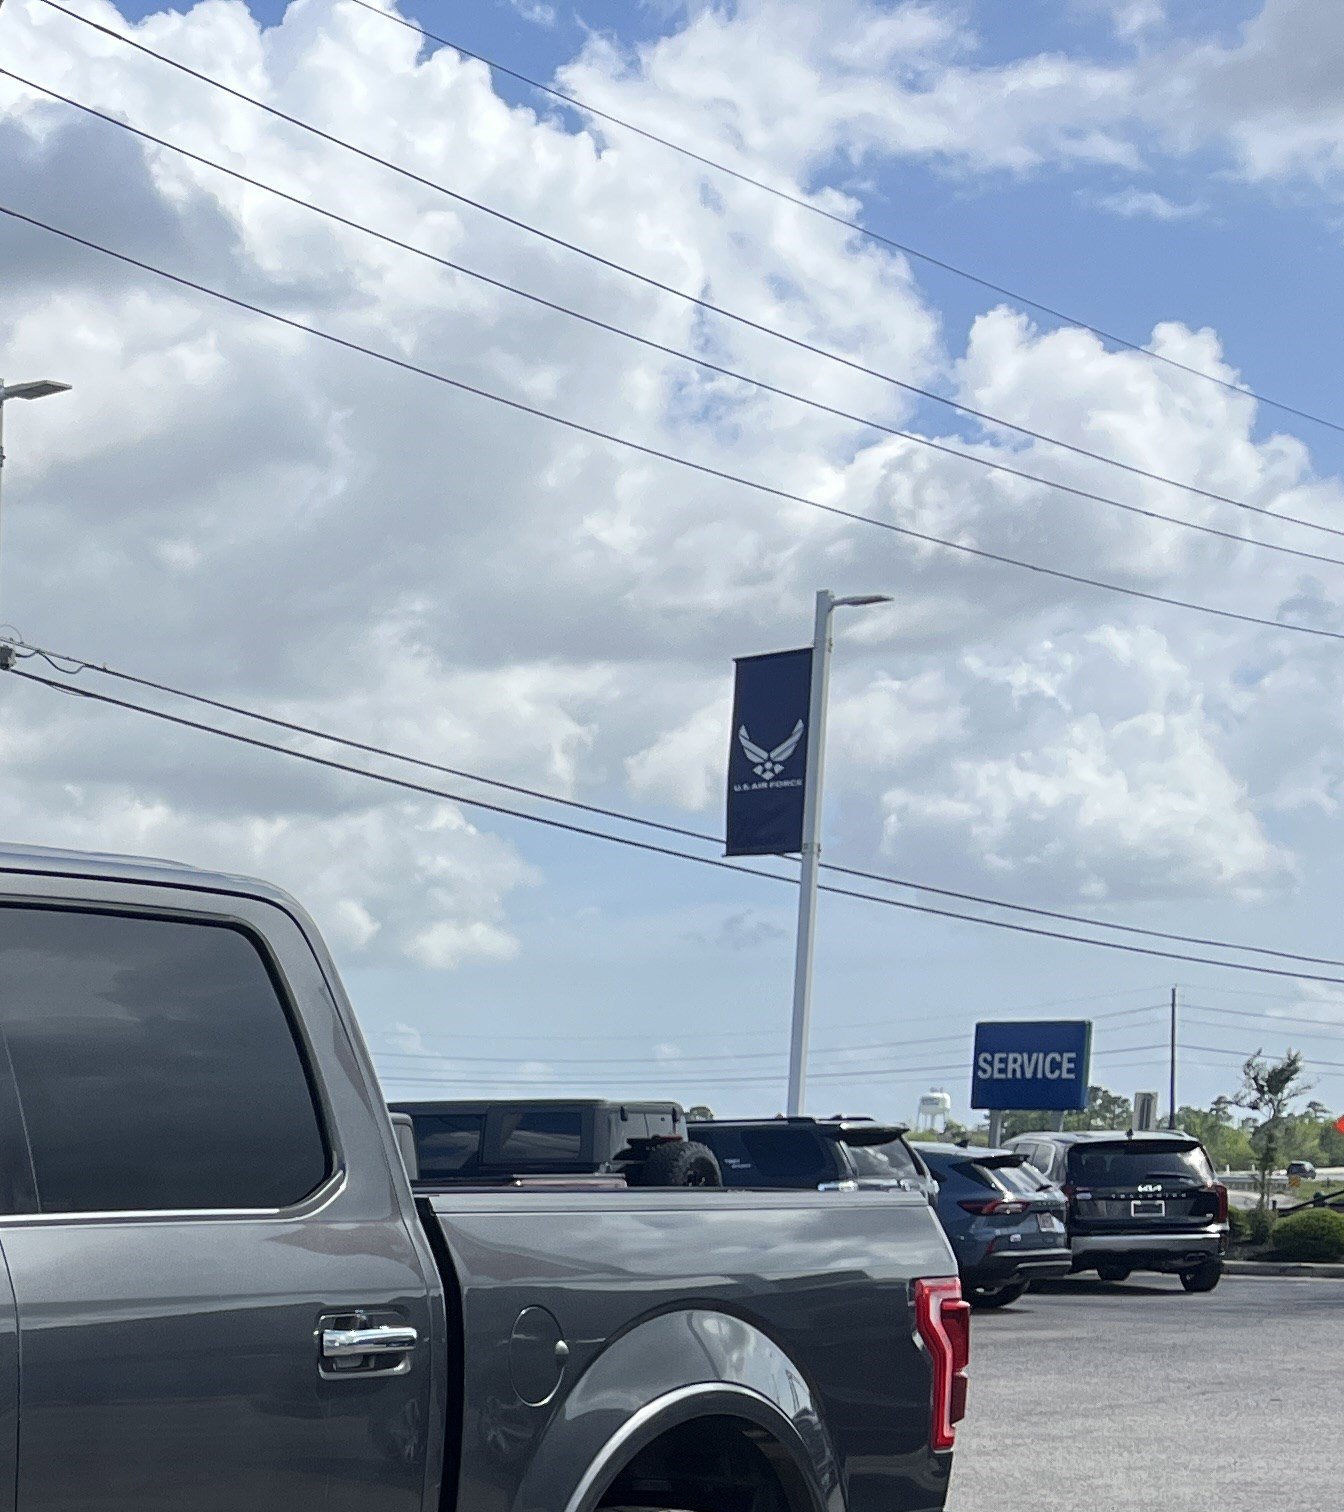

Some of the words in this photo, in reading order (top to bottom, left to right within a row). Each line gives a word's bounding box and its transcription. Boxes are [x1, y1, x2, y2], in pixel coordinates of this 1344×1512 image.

[751, 781, 768, 790] AIR
[769, 779, 802, 789] FORCE
[977, 1052, 1076, 1079] SERVICE
